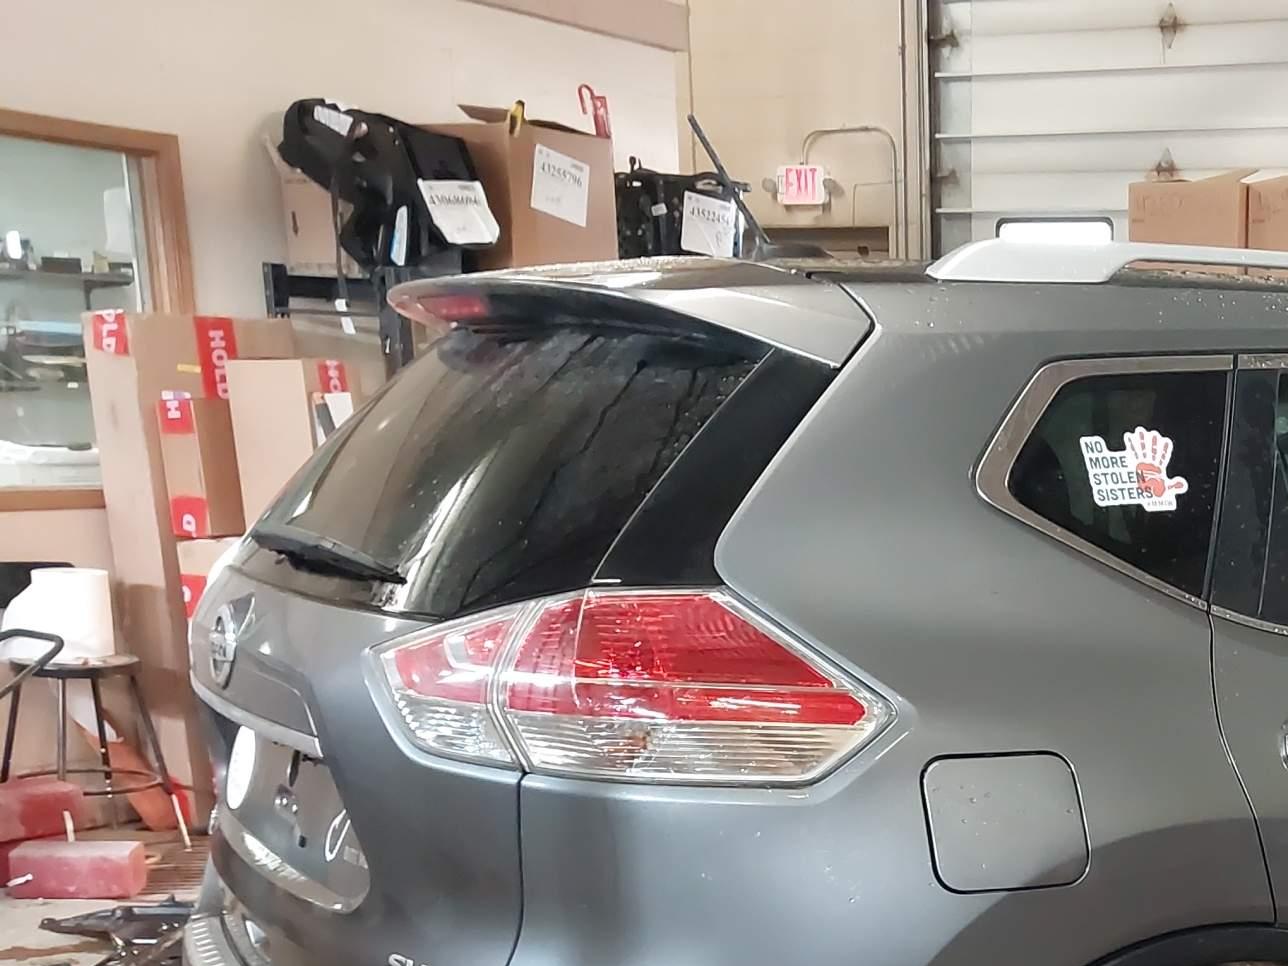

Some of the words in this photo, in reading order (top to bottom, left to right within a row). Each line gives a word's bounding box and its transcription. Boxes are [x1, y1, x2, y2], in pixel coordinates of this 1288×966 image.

[785, 167, 817, 200] EXIT
[1084, 441, 1104, 454] NO
[1088, 456, 1129, 470] MORE
[1092, 470, 1146, 486] STOLEN
[1096, 487, 1155, 502] SISTERS
